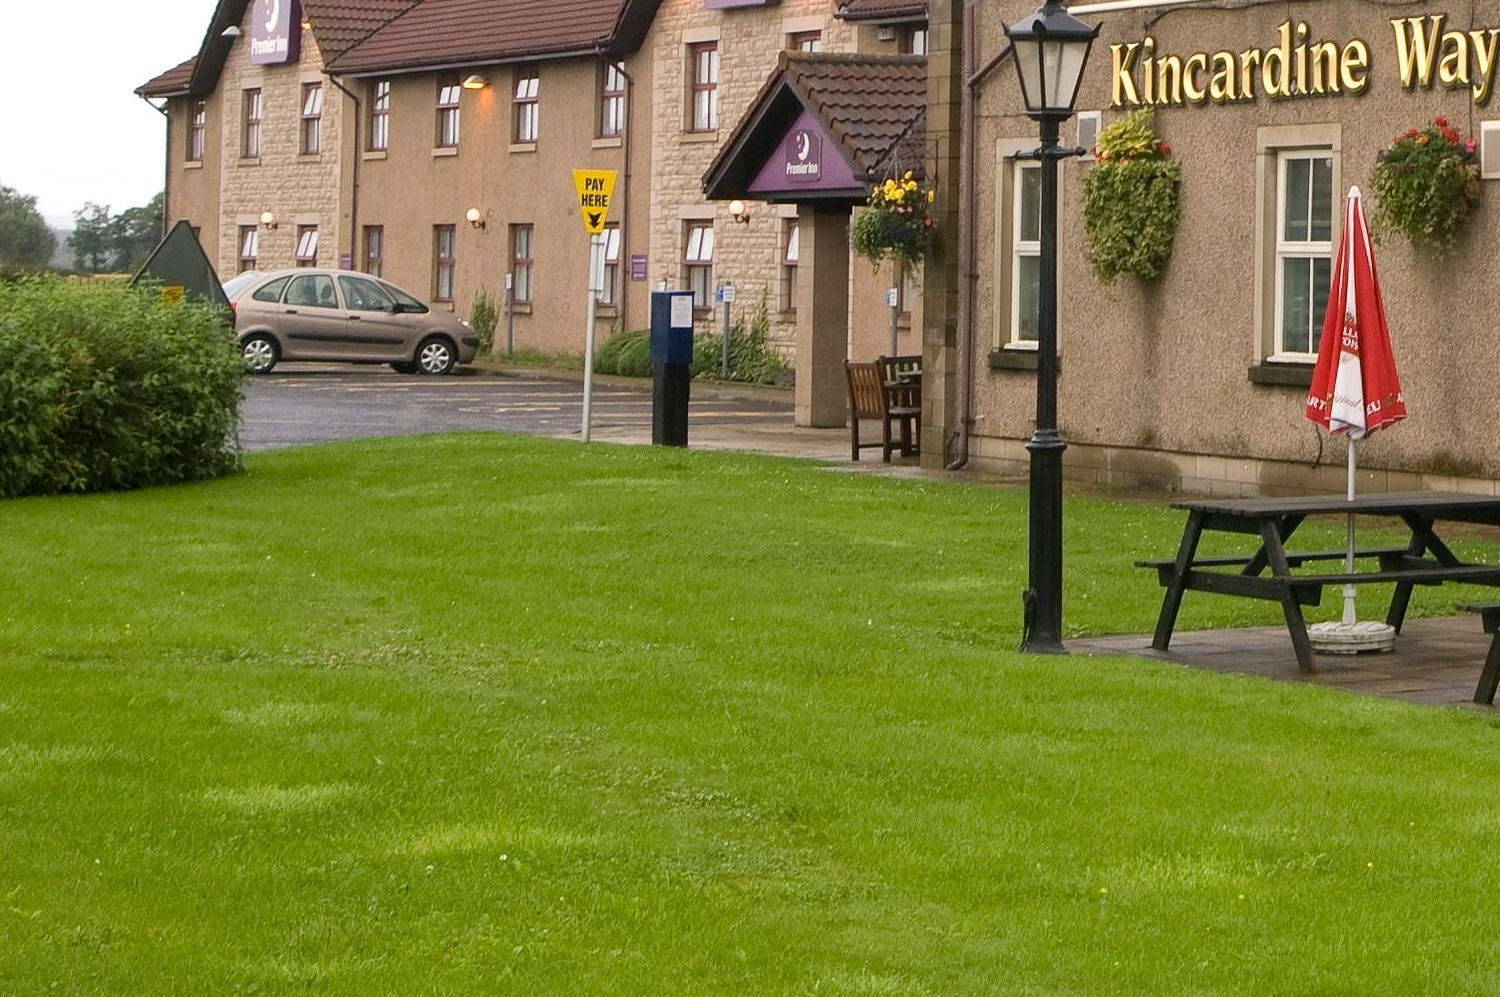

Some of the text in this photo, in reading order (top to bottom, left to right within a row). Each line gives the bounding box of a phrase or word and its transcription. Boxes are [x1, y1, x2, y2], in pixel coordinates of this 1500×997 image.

[251, 34, 288, 55] Premier Inn
[1109, 20, 1370, 108] Kincardine
[786, 161, 818, 175] Premier Inn
[585, 178, 605, 191] PAY
[581, 193, 608, 207] HERE
